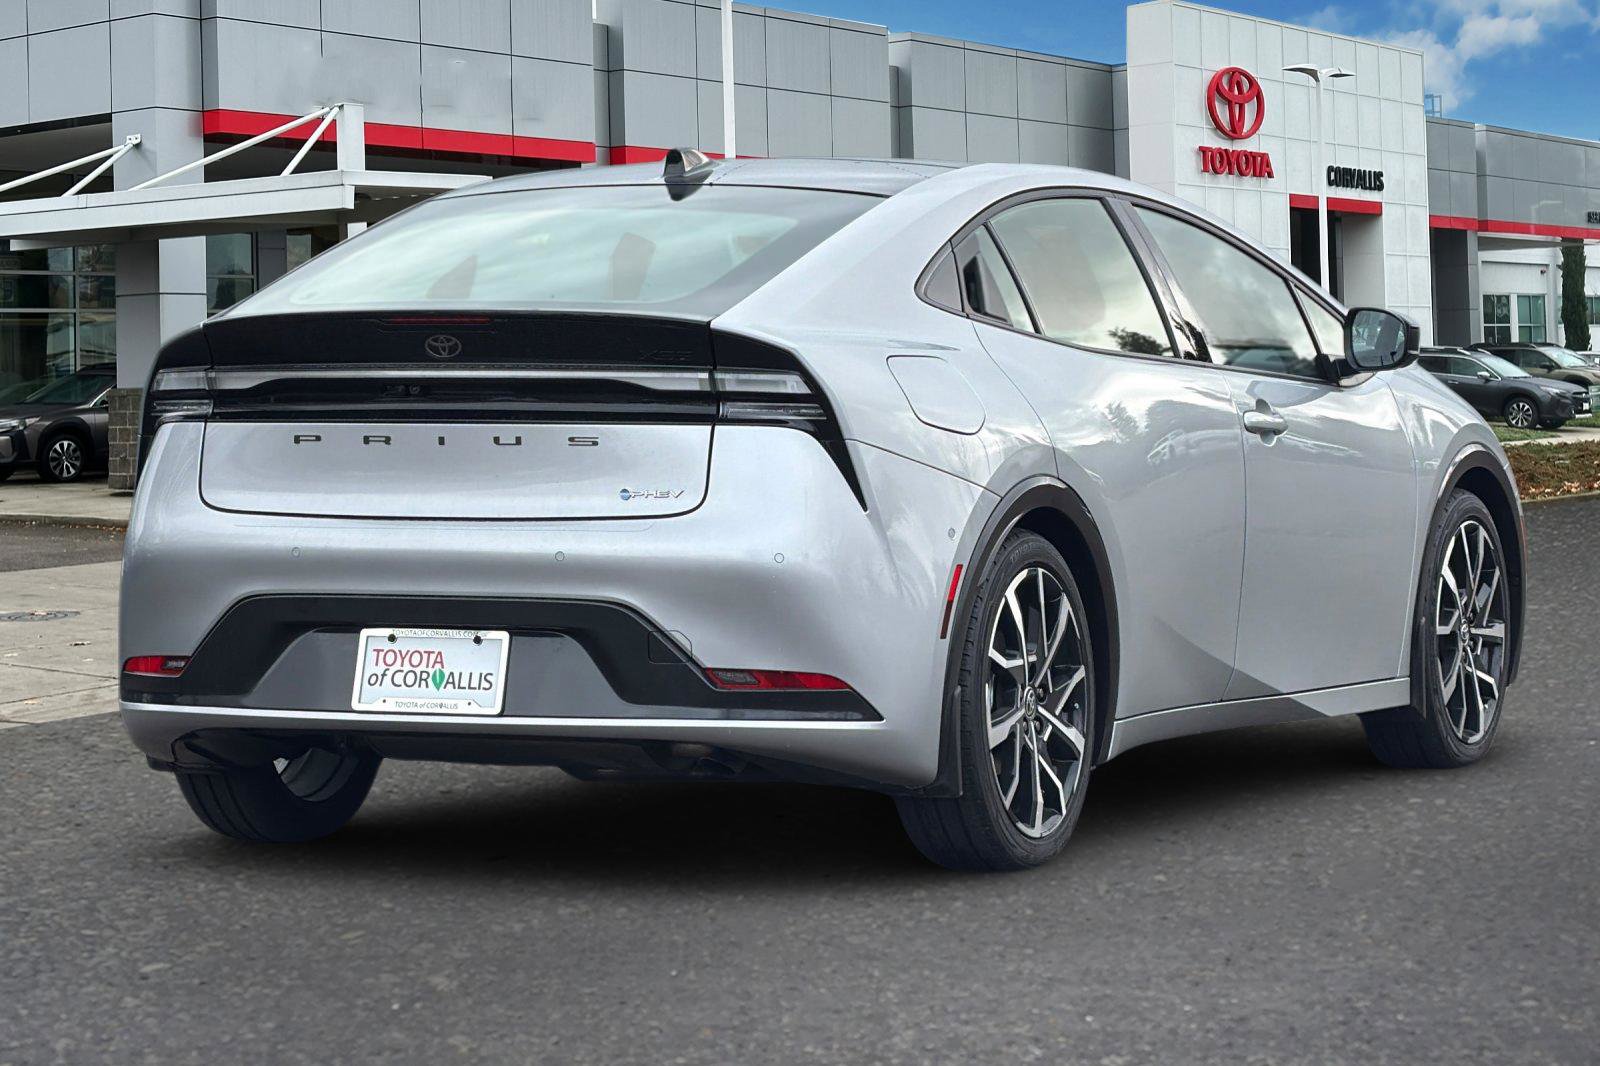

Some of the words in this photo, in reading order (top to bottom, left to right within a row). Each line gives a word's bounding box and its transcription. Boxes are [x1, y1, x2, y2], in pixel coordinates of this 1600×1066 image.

[1199, 145, 1274, 179] TOYOTA
[1326, 165, 1385, 192] CORVALLIS
[294, 435, 599, 446] PRIUS
[631, 489, 685, 499] PHEV
[372, 648, 445, 669] TOYOTA
[367, 668, 390, 687] of
[395, 701, 418, 709] TOYOTA
